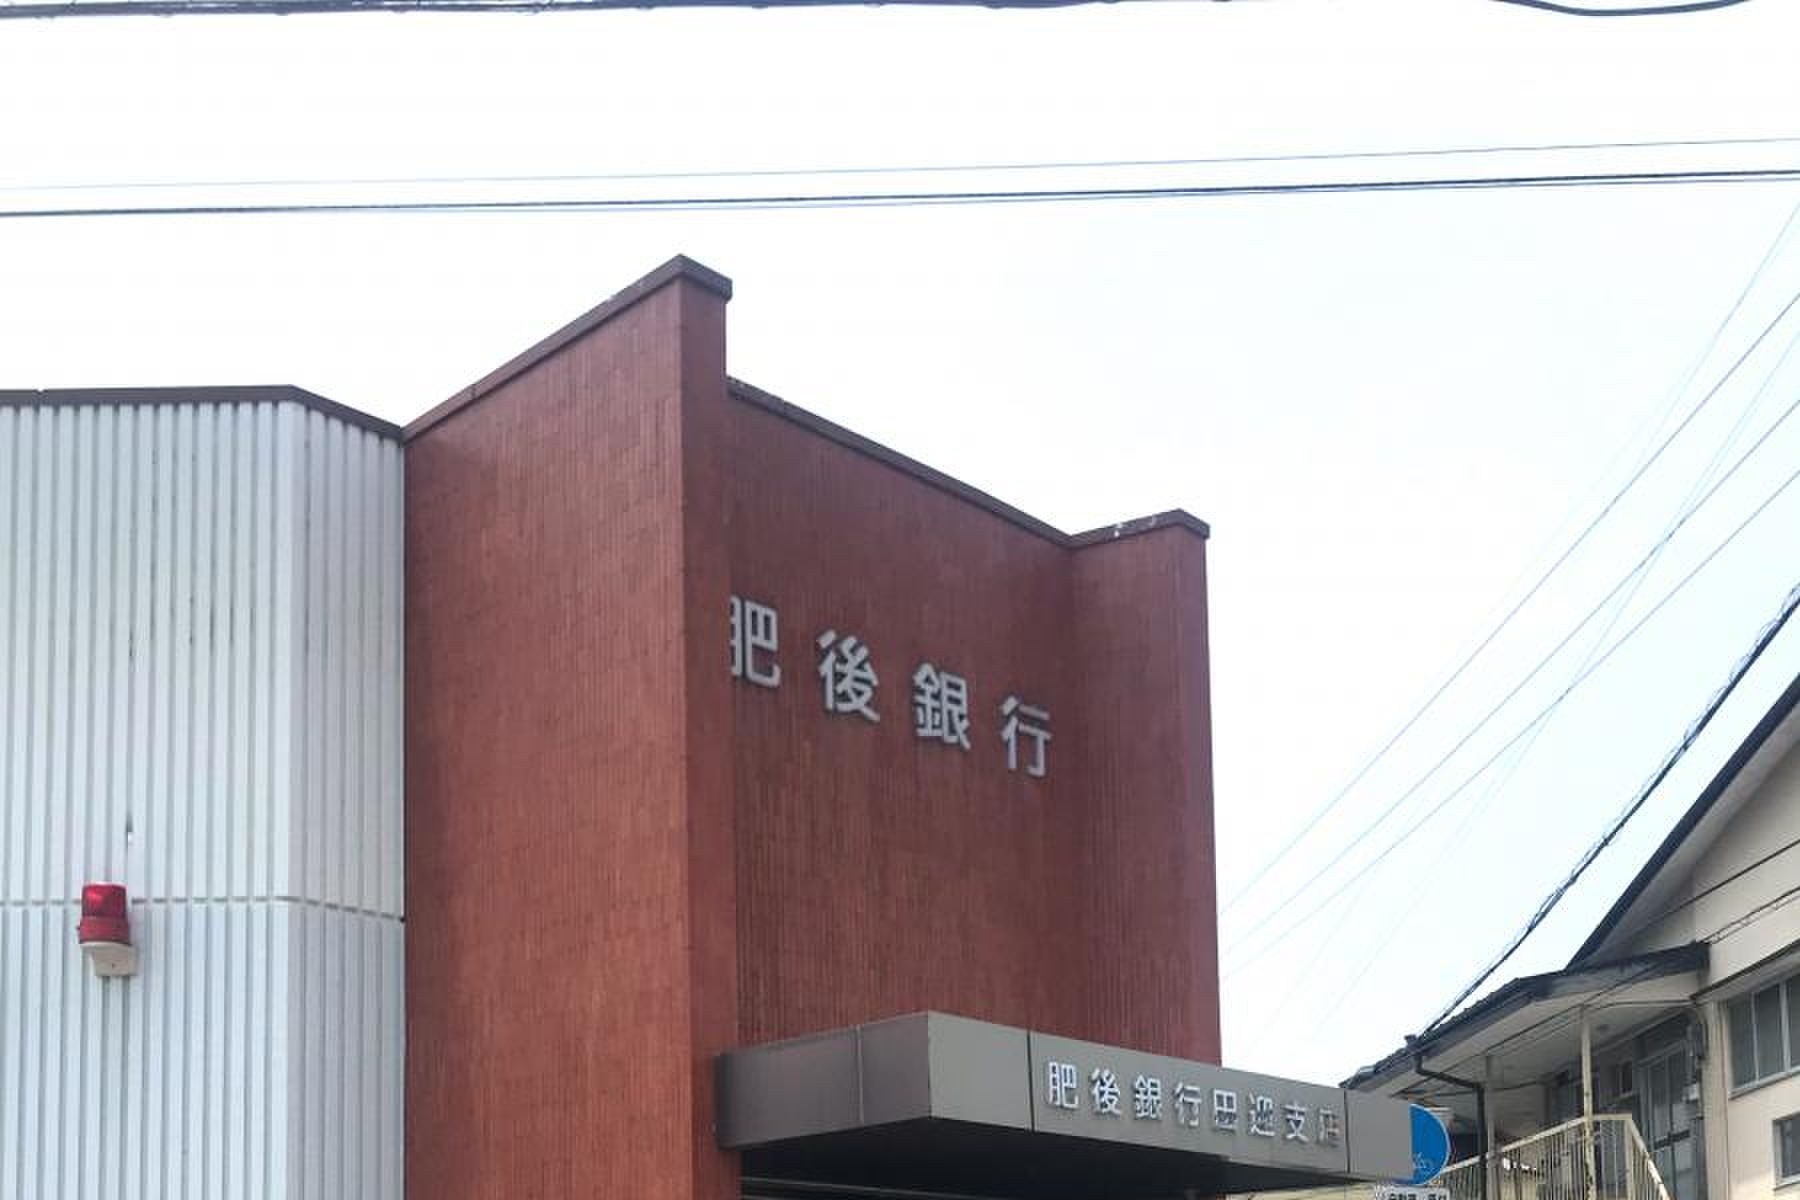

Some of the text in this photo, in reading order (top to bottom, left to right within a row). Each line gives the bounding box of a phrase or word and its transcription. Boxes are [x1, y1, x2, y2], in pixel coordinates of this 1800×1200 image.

[730, 595, 1052, 777] 肥後銀行
[1047, 1060, 1341, 1147] 肥後銀行田迎支店
